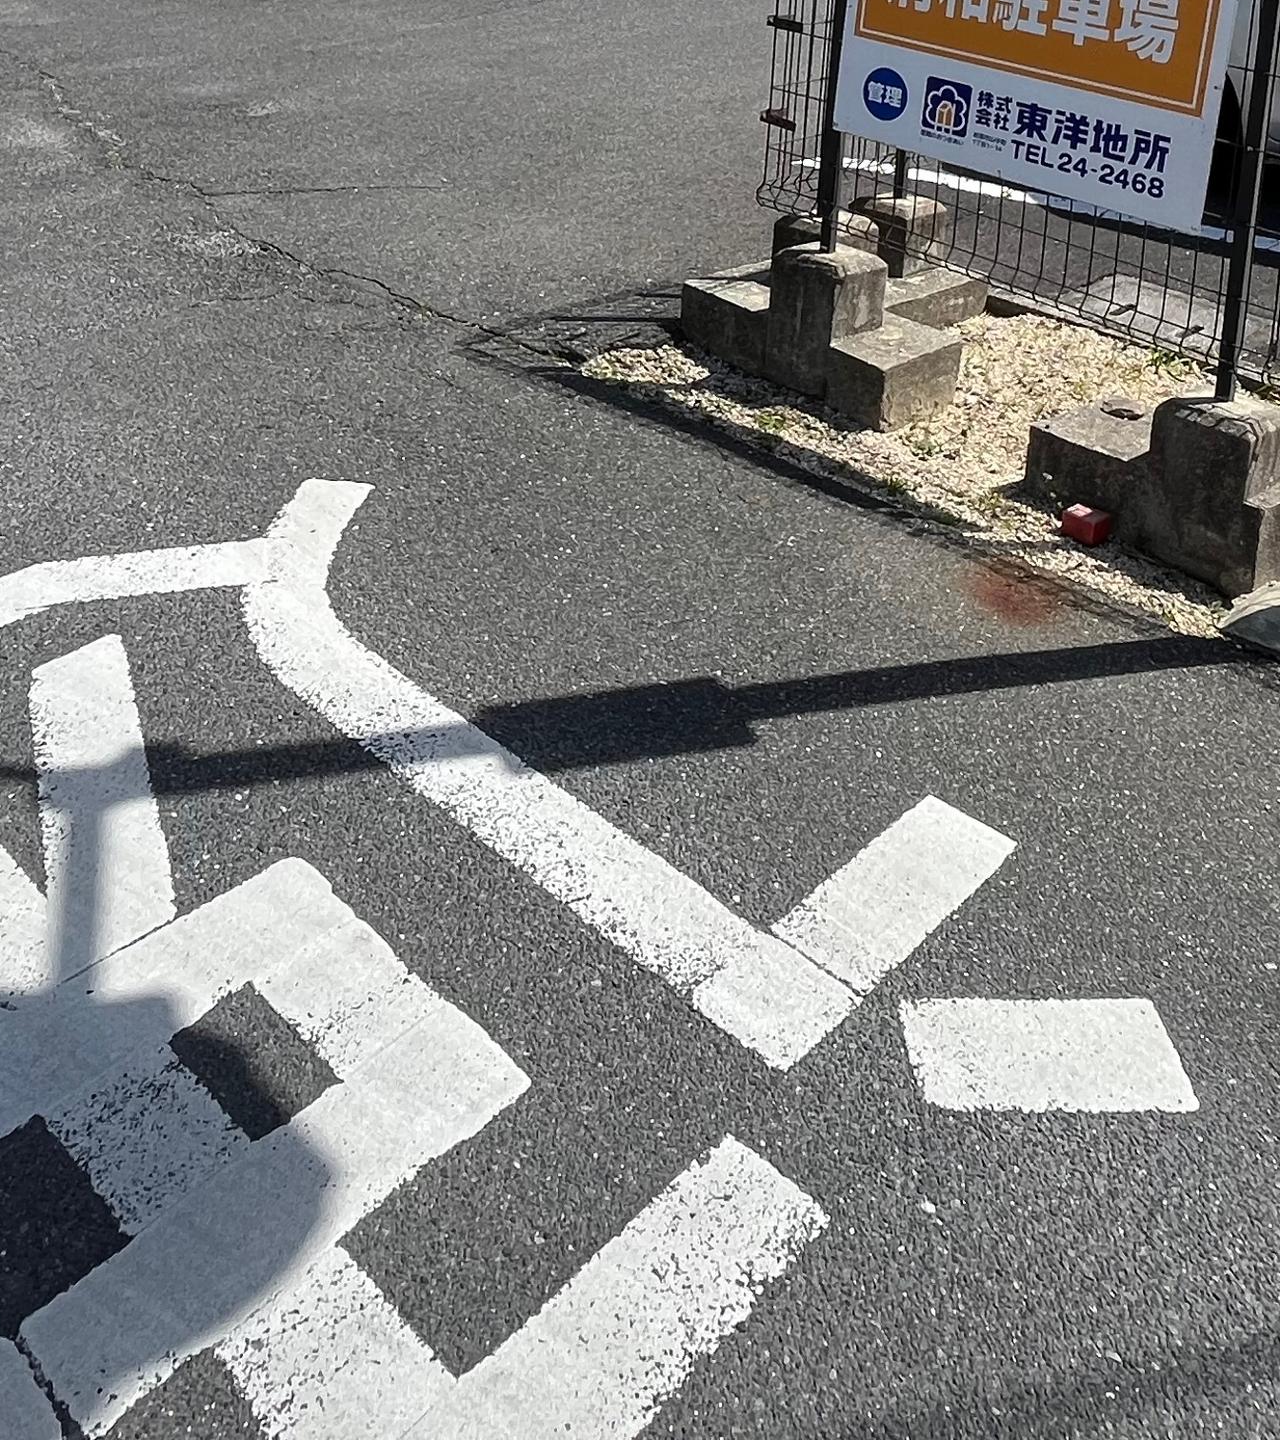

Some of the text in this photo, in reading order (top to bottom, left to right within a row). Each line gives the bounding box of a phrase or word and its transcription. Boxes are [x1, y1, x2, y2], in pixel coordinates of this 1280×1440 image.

[867, 80, 903, 109] 管理
[1011, 101, 1172, 173] 東洋地所
